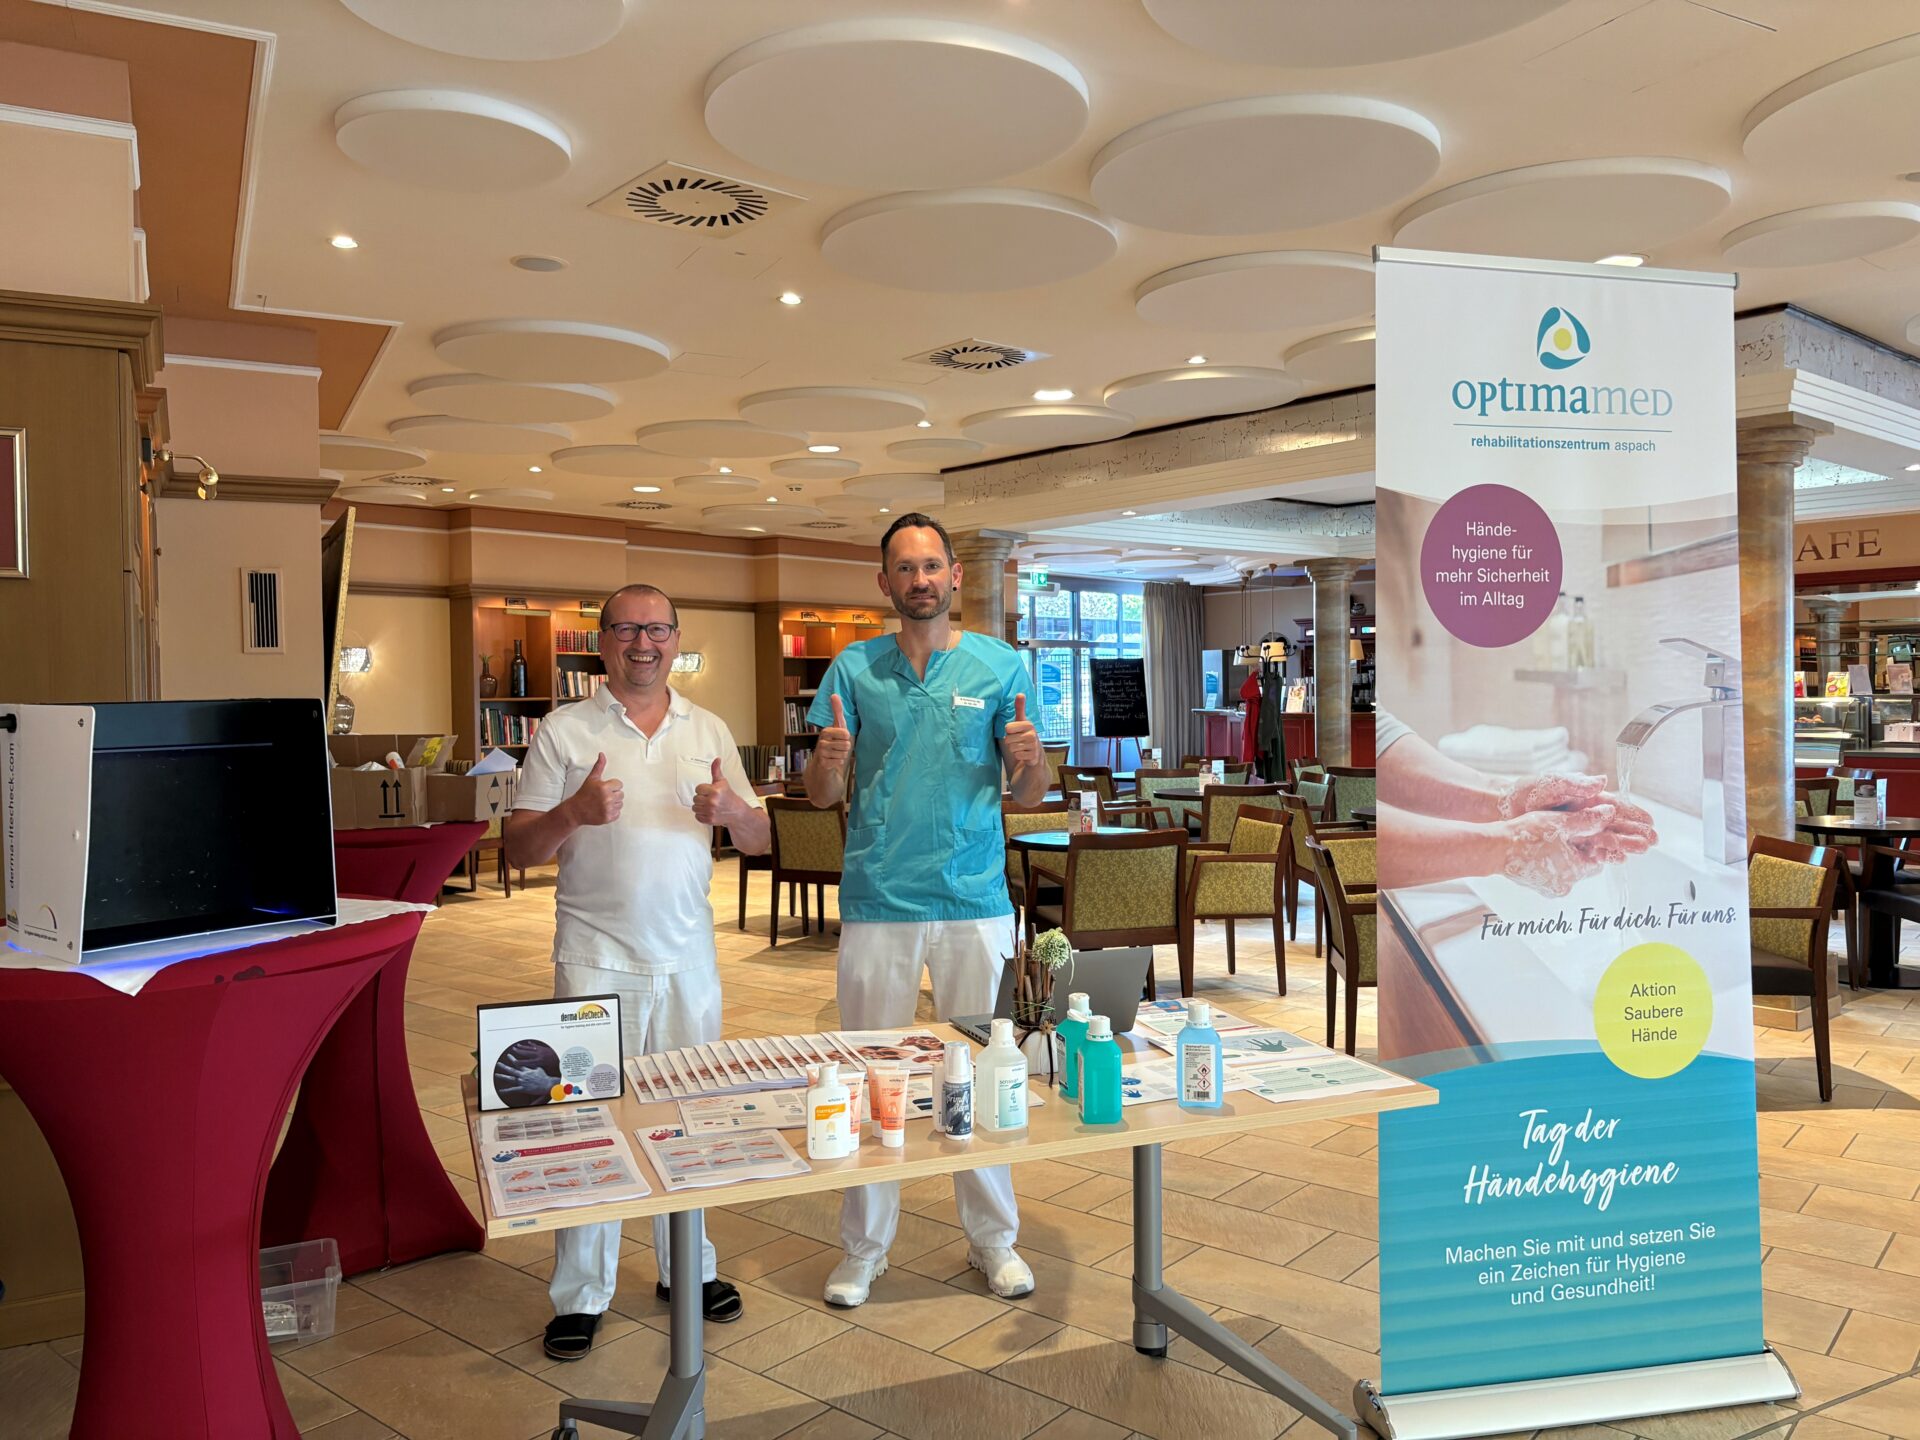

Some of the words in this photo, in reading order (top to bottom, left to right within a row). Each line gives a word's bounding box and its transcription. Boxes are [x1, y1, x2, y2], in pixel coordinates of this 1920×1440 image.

[1471, 434, 1611, 452] rehabilitationszentrum
[1614, 438, 1656, 454] aspach
[1465, 521, 1518, 538] Hände-
[1451, 545, 1507, 563] hygiene
[1511, 544, 1533, 560] für
[1795, 528, 1883, 563] AFE
[1435, 568, 1473, 583] mehr
[1477, 568, 1550, 583] Sicherheit
[1459, 591, 1478, 606] im
[1481, 591, 1525, 609] Alltag
[1480, 912, 1515, 940] Für
[1516, 911, 1573, 936] mich.
[1578, 907, 1613, 934] Für
[1613, 905, 1662, 929] dich.
[1667, 902, 1697, 929] Für
[1701, 905, 1737, 926] uns.
[1630, 983, 1677, 998] Aktion
[1623, 1005, 1684, 1021] Saubere
[1631, 1027, 1678, 1043] Hände
[1518, 1108, 1574, 1166] Tag
[1574, 1108, 1621, 1142] der
[1463, 1160, 1680, 1212] Händehygiene
[1445, 1242, 1517, 1266] Machen
[1522, 1239, 1551, 1258] Sie
[1556, 1235, 1586, 1255] mit
[1590, 1231, 1624, 1250] und
[1629, 1226, 1685, 1246] setzen
[1689, 1222, 1717, 1240] Sie
[1478, 1267, 1506, 1286] ein
[1511, 1261, 1581, 1282] Zeichen
[1585, 1256, 1612, 1275] für
[1616, 1250, 1687, 1276] Hygiene
[1510, 1286, 1545, 1306] und
[1550, 1273, 1656, 1302] Gesundheit!
